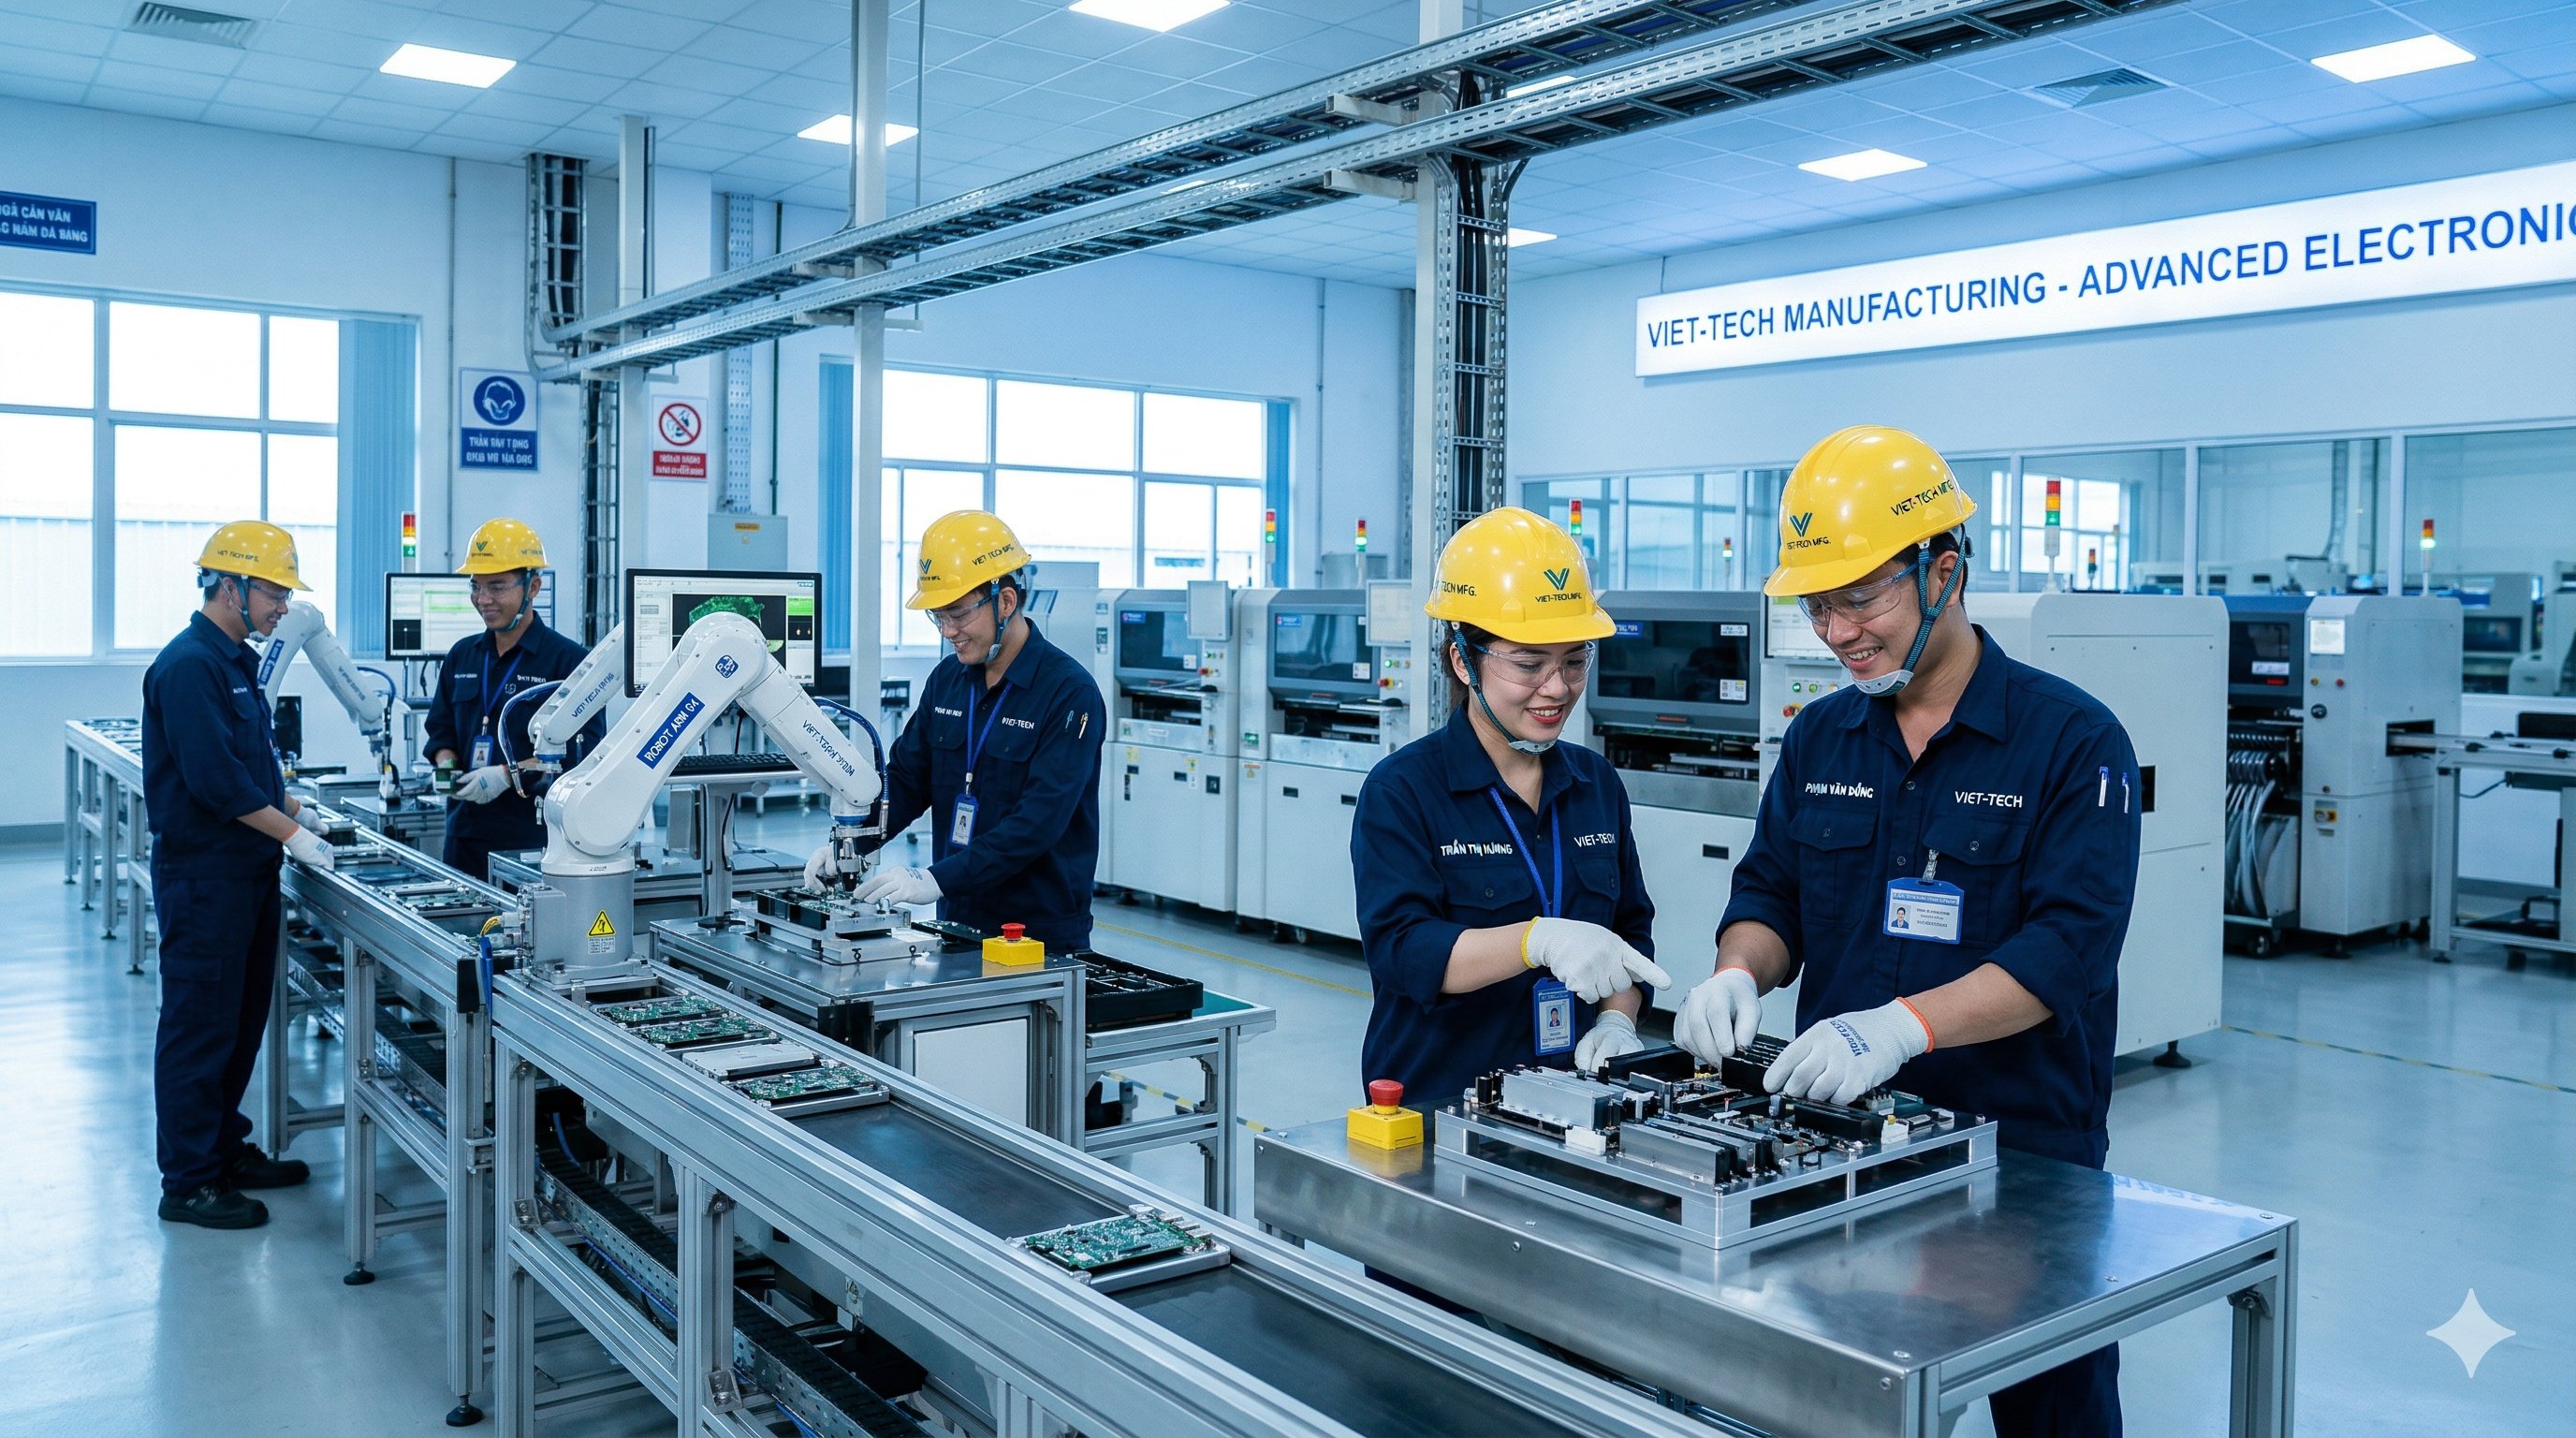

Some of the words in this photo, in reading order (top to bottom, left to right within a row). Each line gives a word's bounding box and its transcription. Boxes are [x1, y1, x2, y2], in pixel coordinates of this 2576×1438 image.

[1648, 308, 1775, 347] VIET-TECH
[1784, 272, 2046, 332] MANUFACTURING
[2078, 241, 2289, 298] ADVANCED
[2305, 202, 2576, 271] ELECTRONI
[1954, 790, 2023, 808] VIET-TECH
